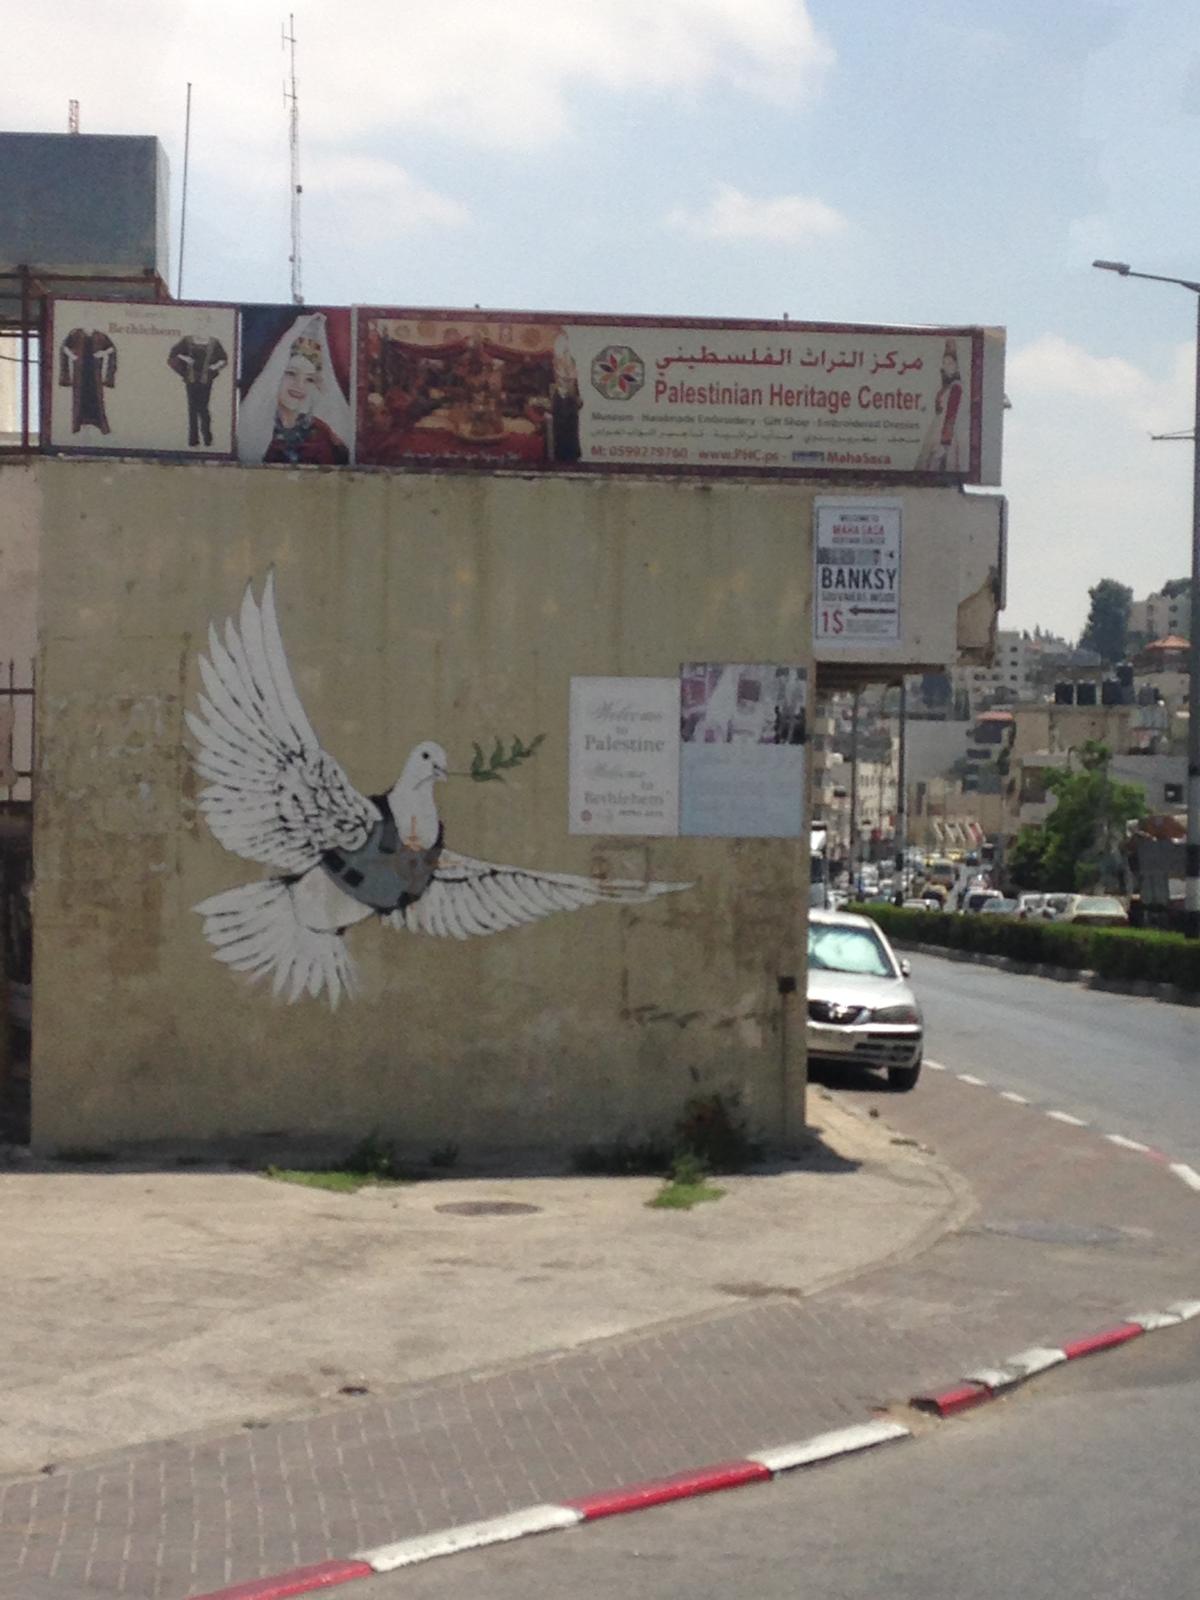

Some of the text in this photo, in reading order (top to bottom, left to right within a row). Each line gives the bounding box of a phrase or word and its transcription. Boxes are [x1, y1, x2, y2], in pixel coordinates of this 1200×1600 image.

[655, 345, 924, 377] مركز التراث الفلسطيني
[655, 380, 763, 406] Palestinian
[769, 383, 851, 414] Heritage
[821, 567, 896, 590] BANKSY
[584, 734, 665, 753] Palestine
